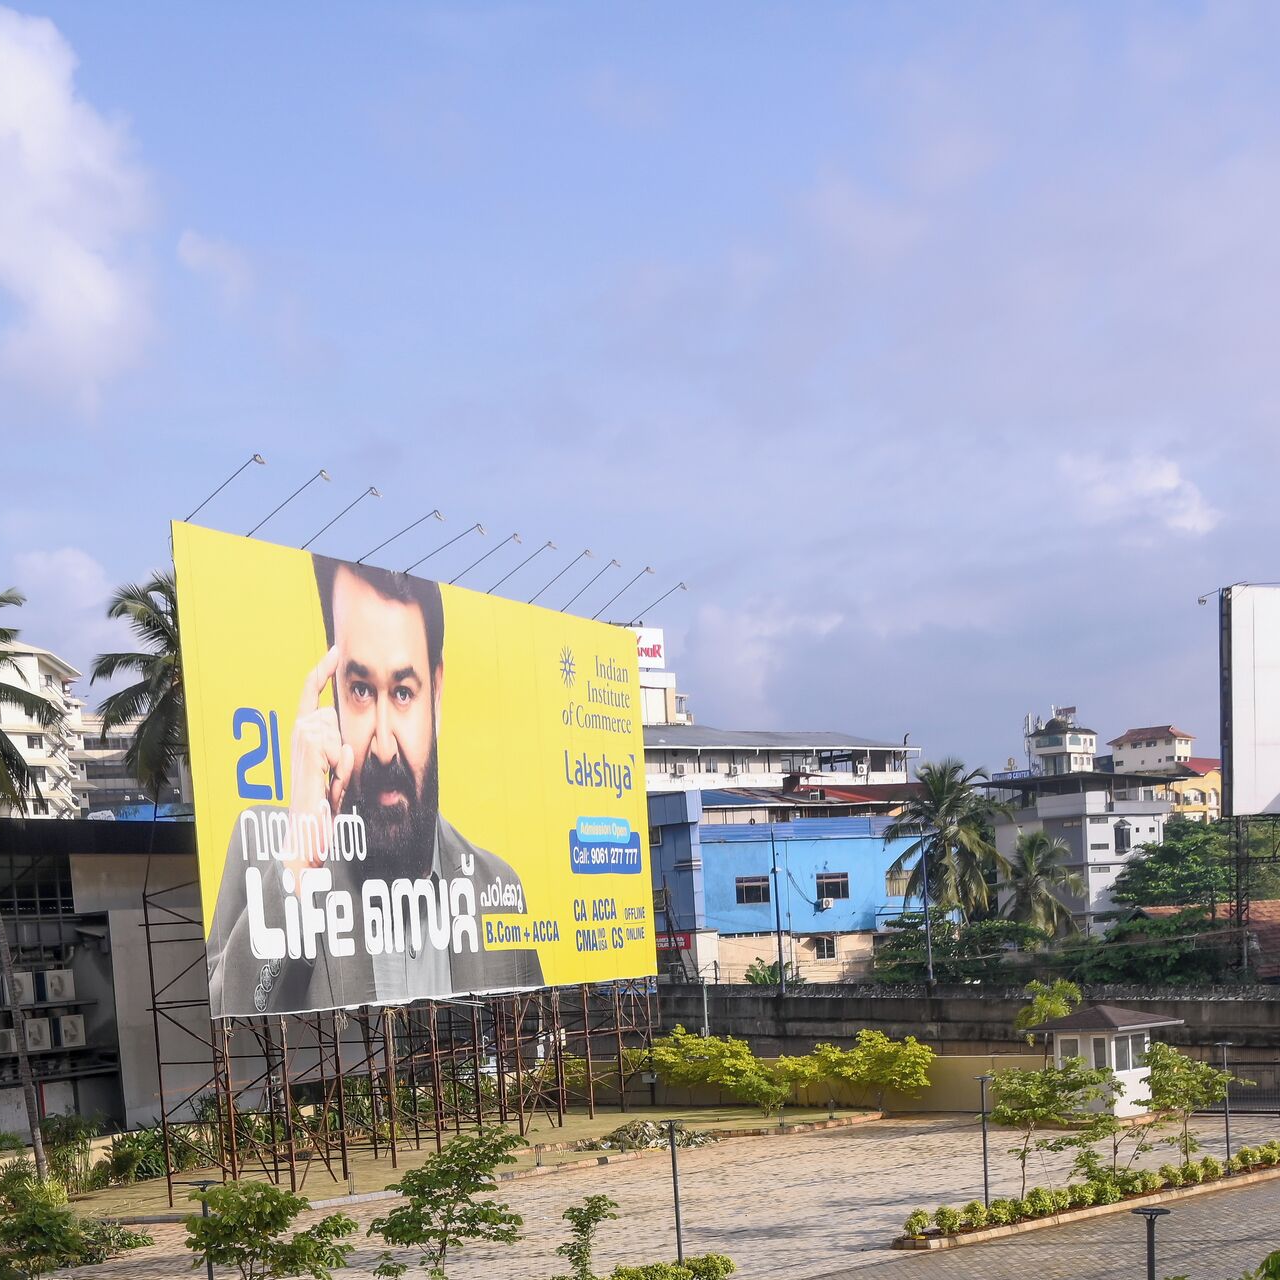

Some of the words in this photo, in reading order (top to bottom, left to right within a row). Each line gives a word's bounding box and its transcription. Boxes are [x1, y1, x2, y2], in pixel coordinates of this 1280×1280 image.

[595, 655, 629, 683] Indian
[587, 680, 630, 709] Institute
[562, 701, 575, 726] of
[576, 705, 632, 734] Commerce
[233, 707, 284, 801] 21
[564, 750, 633, 798] Lakshya
[581, 821, 611, 834] Admission
[612, 822, 627, 836] Open
[573, 846, 589, 864] Call:
[591, 847, 609, 864] 9061
[610, 848, 624, 864] 277
[624, 848, 638, 864] 777
[573, 898, 587, 922] CA
[592, 898, 617, 922] ACCA
[624, 906, 645, 921] OFFLINE
[486, 920, 521, 944] B.Com
[532, 920, 560, 943] ACCA
[576, 927, 598, 952] CMA
[611, 927, 624, 949] CS
[626, 926, 645, 941] ONLINE
